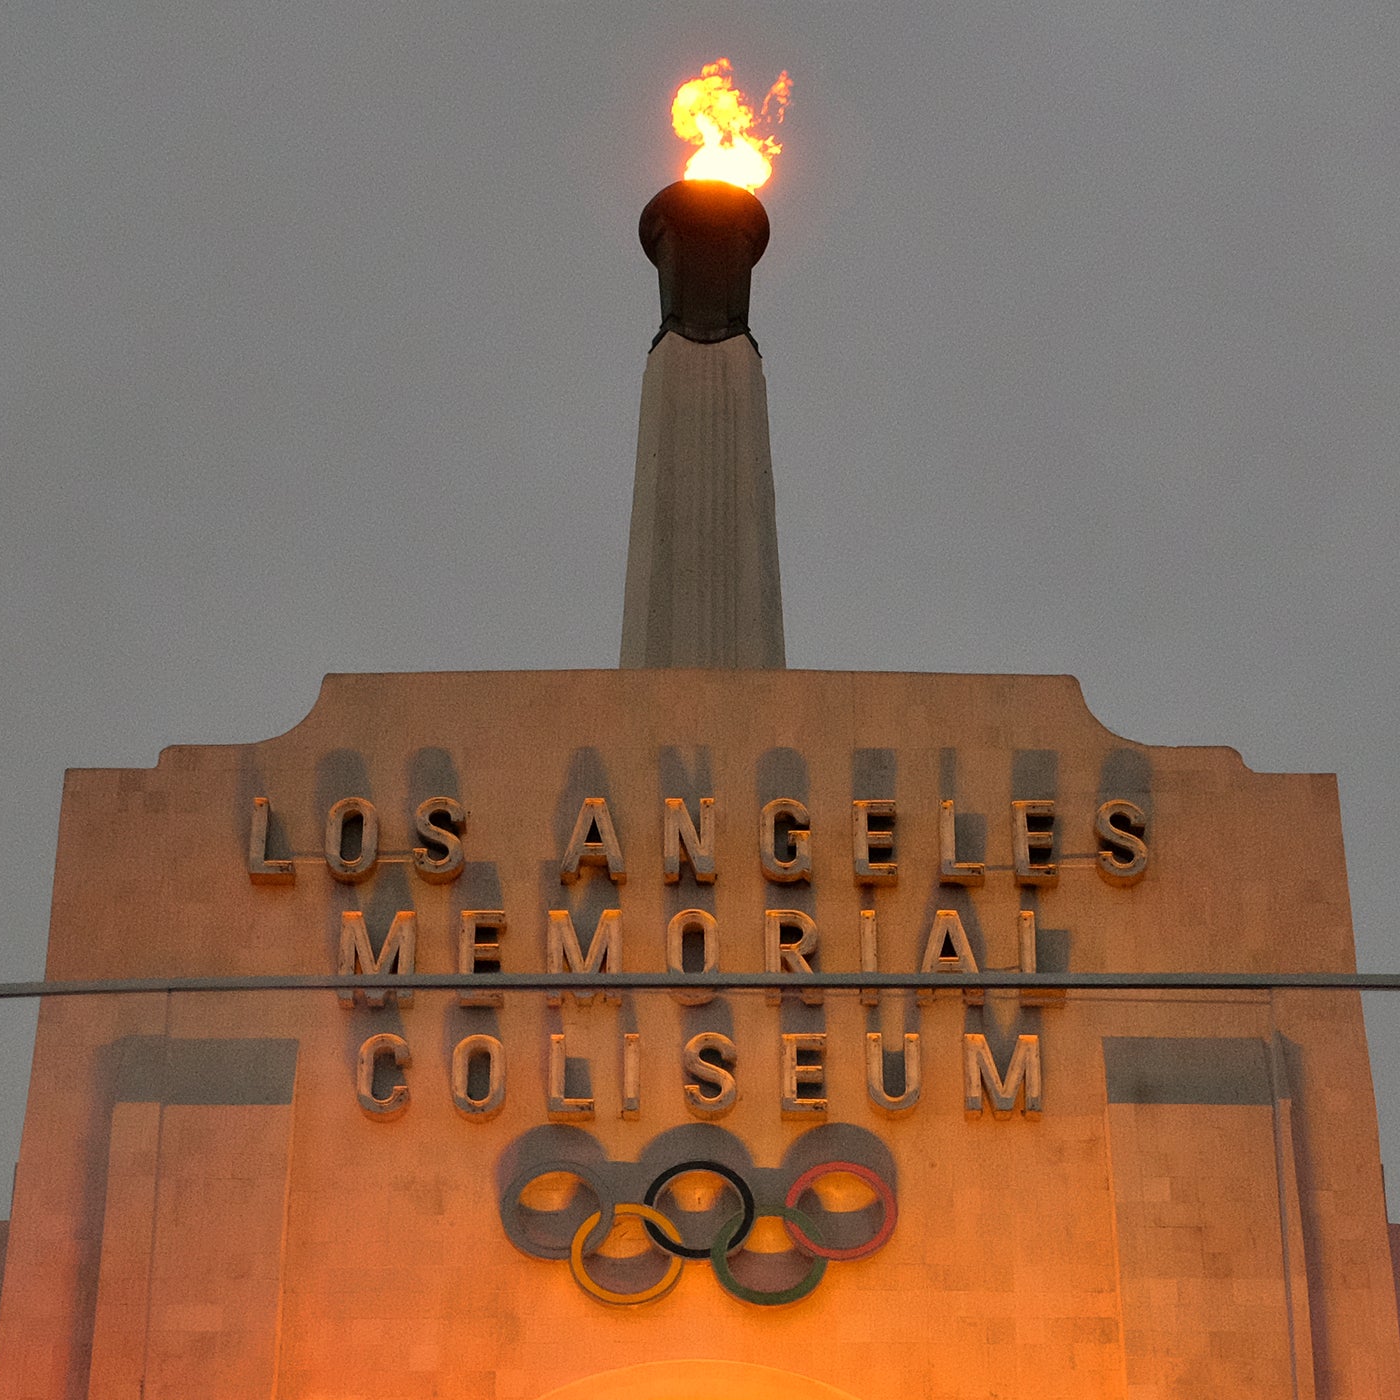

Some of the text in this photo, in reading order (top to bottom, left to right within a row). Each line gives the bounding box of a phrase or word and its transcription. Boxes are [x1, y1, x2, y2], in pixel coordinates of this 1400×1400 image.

[248, 797, 1148, 887] LOS ANGELES
[338, 909, 1067, 1008] MEMORIAL
[356, 1033, 1043, 1122] COLISEUM
